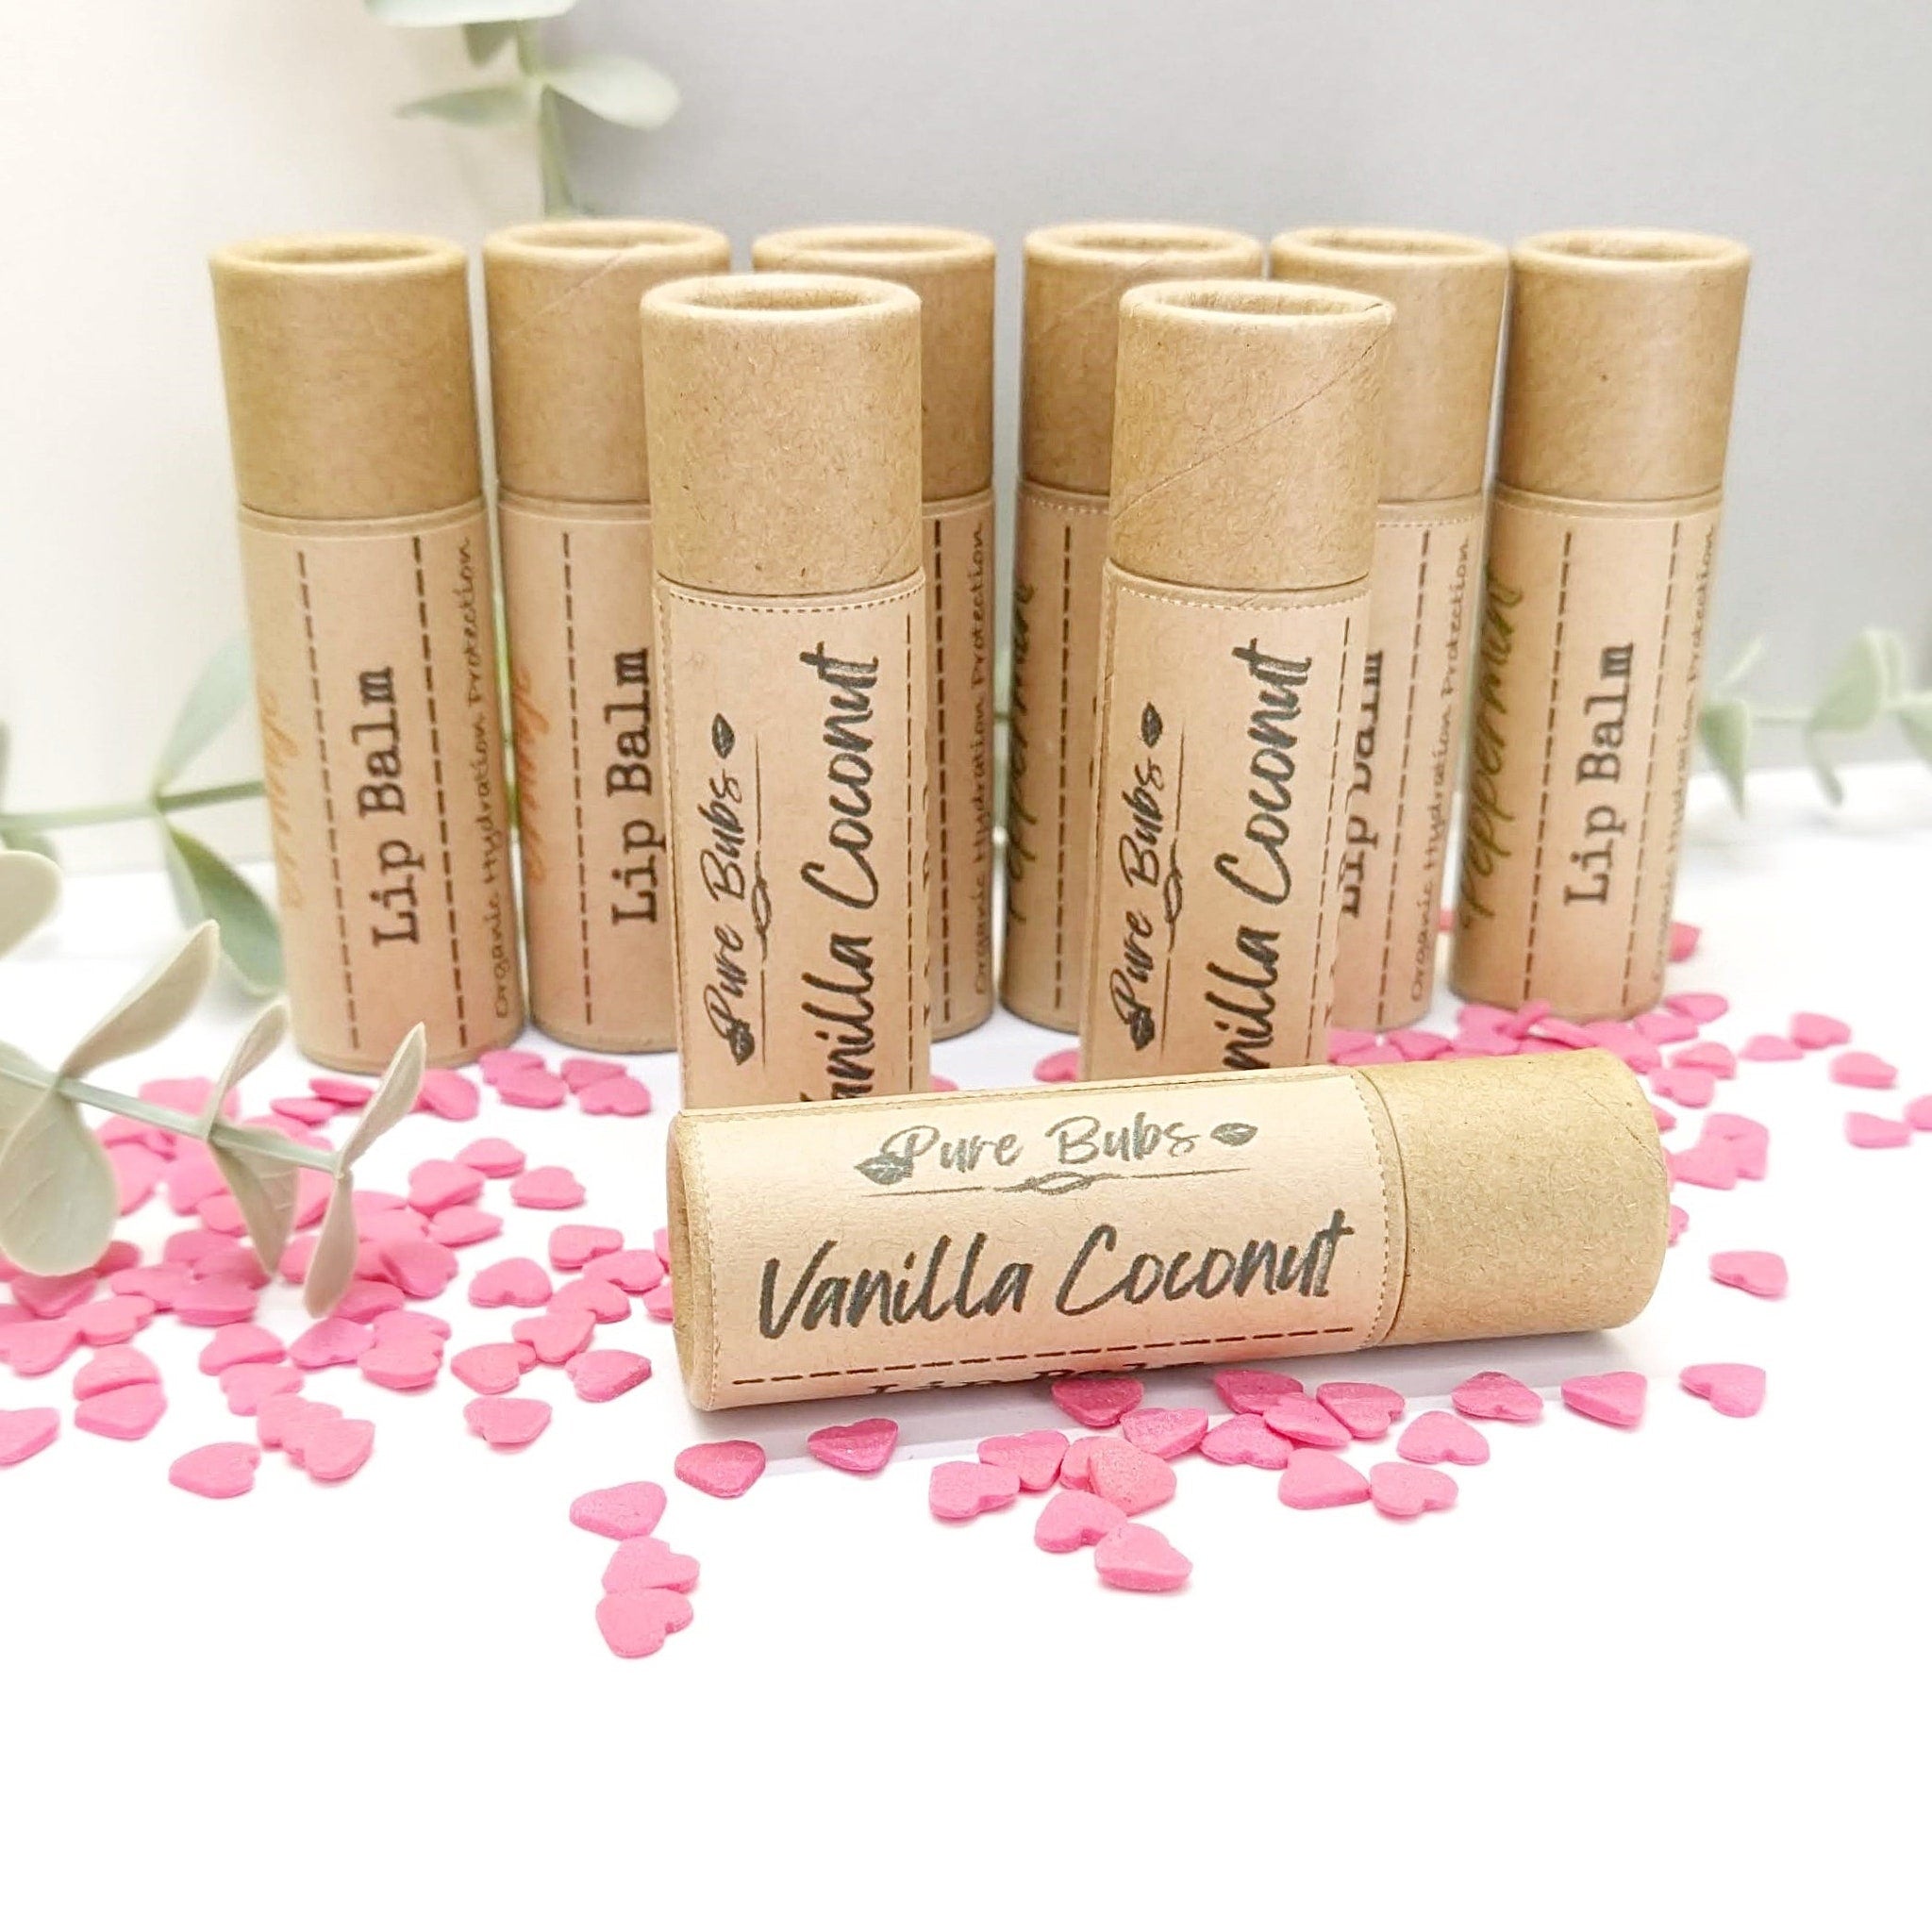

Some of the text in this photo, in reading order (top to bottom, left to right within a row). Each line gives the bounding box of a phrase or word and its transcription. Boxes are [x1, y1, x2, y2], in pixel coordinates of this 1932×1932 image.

[968, 522, 988, 686] Protection
[351, 665, 425, 948] Lip Balm
[457, 538, 511, 1020] Organic Hydration Protection
[603, 647, 668, 926] Lip Balm
[695, 770, 752, 1041] Pure Bubs
[798, 640, 879, 1102] anilla Coconut
[970, 697, 991, 862] Hydration
[1109, 757, 1166, 1026] Pure Bubs
[1205, 637, 1313, 1070] nilla Coconut
[1411, 537, 1470, 1003] Organic Hydration Protection
[1563, 641, 1634, 907] Lip Balm
[758, 1208, 1356, 1340] Vanilla Coconut
[881, 1111, 1201, 1175] Pure Bubs
